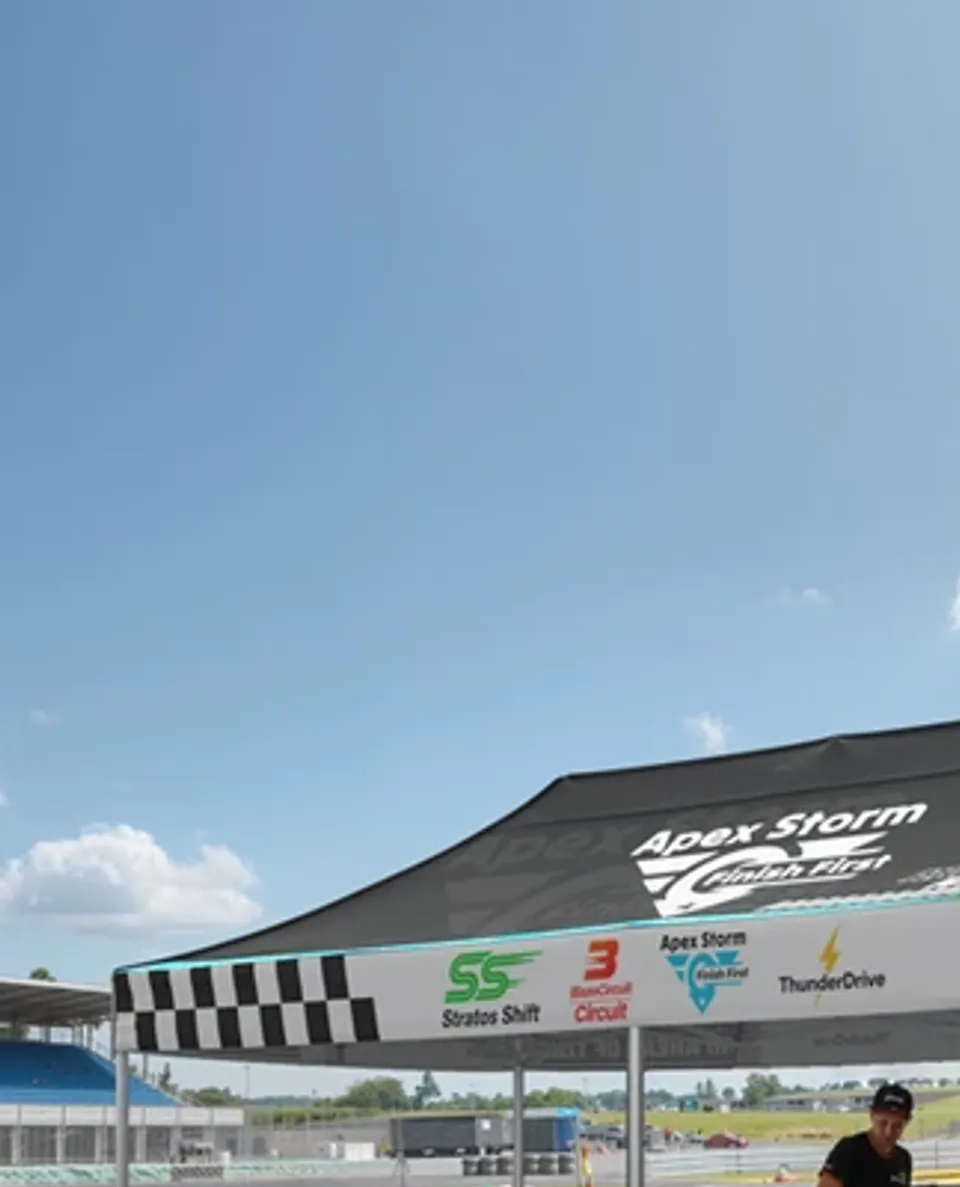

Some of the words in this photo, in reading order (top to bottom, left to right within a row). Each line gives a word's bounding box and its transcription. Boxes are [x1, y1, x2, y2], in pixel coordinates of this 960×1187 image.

[630, 822, 764, 857] Apex
[765, 802, 928, 840] Storm
[702, 863, 806, 887] Finish
[809, 854, 893, 876] First
[660, 934, 697, 953] Apex
[701, 931, 747, 949] Storm
[778, 970, 886, 994] ThunderDrive
[441, 1008, 498, 1029] Stratos
[501, 1003, 541, 1026] Shift
[574, 1003, 627, 1023] Circuit
